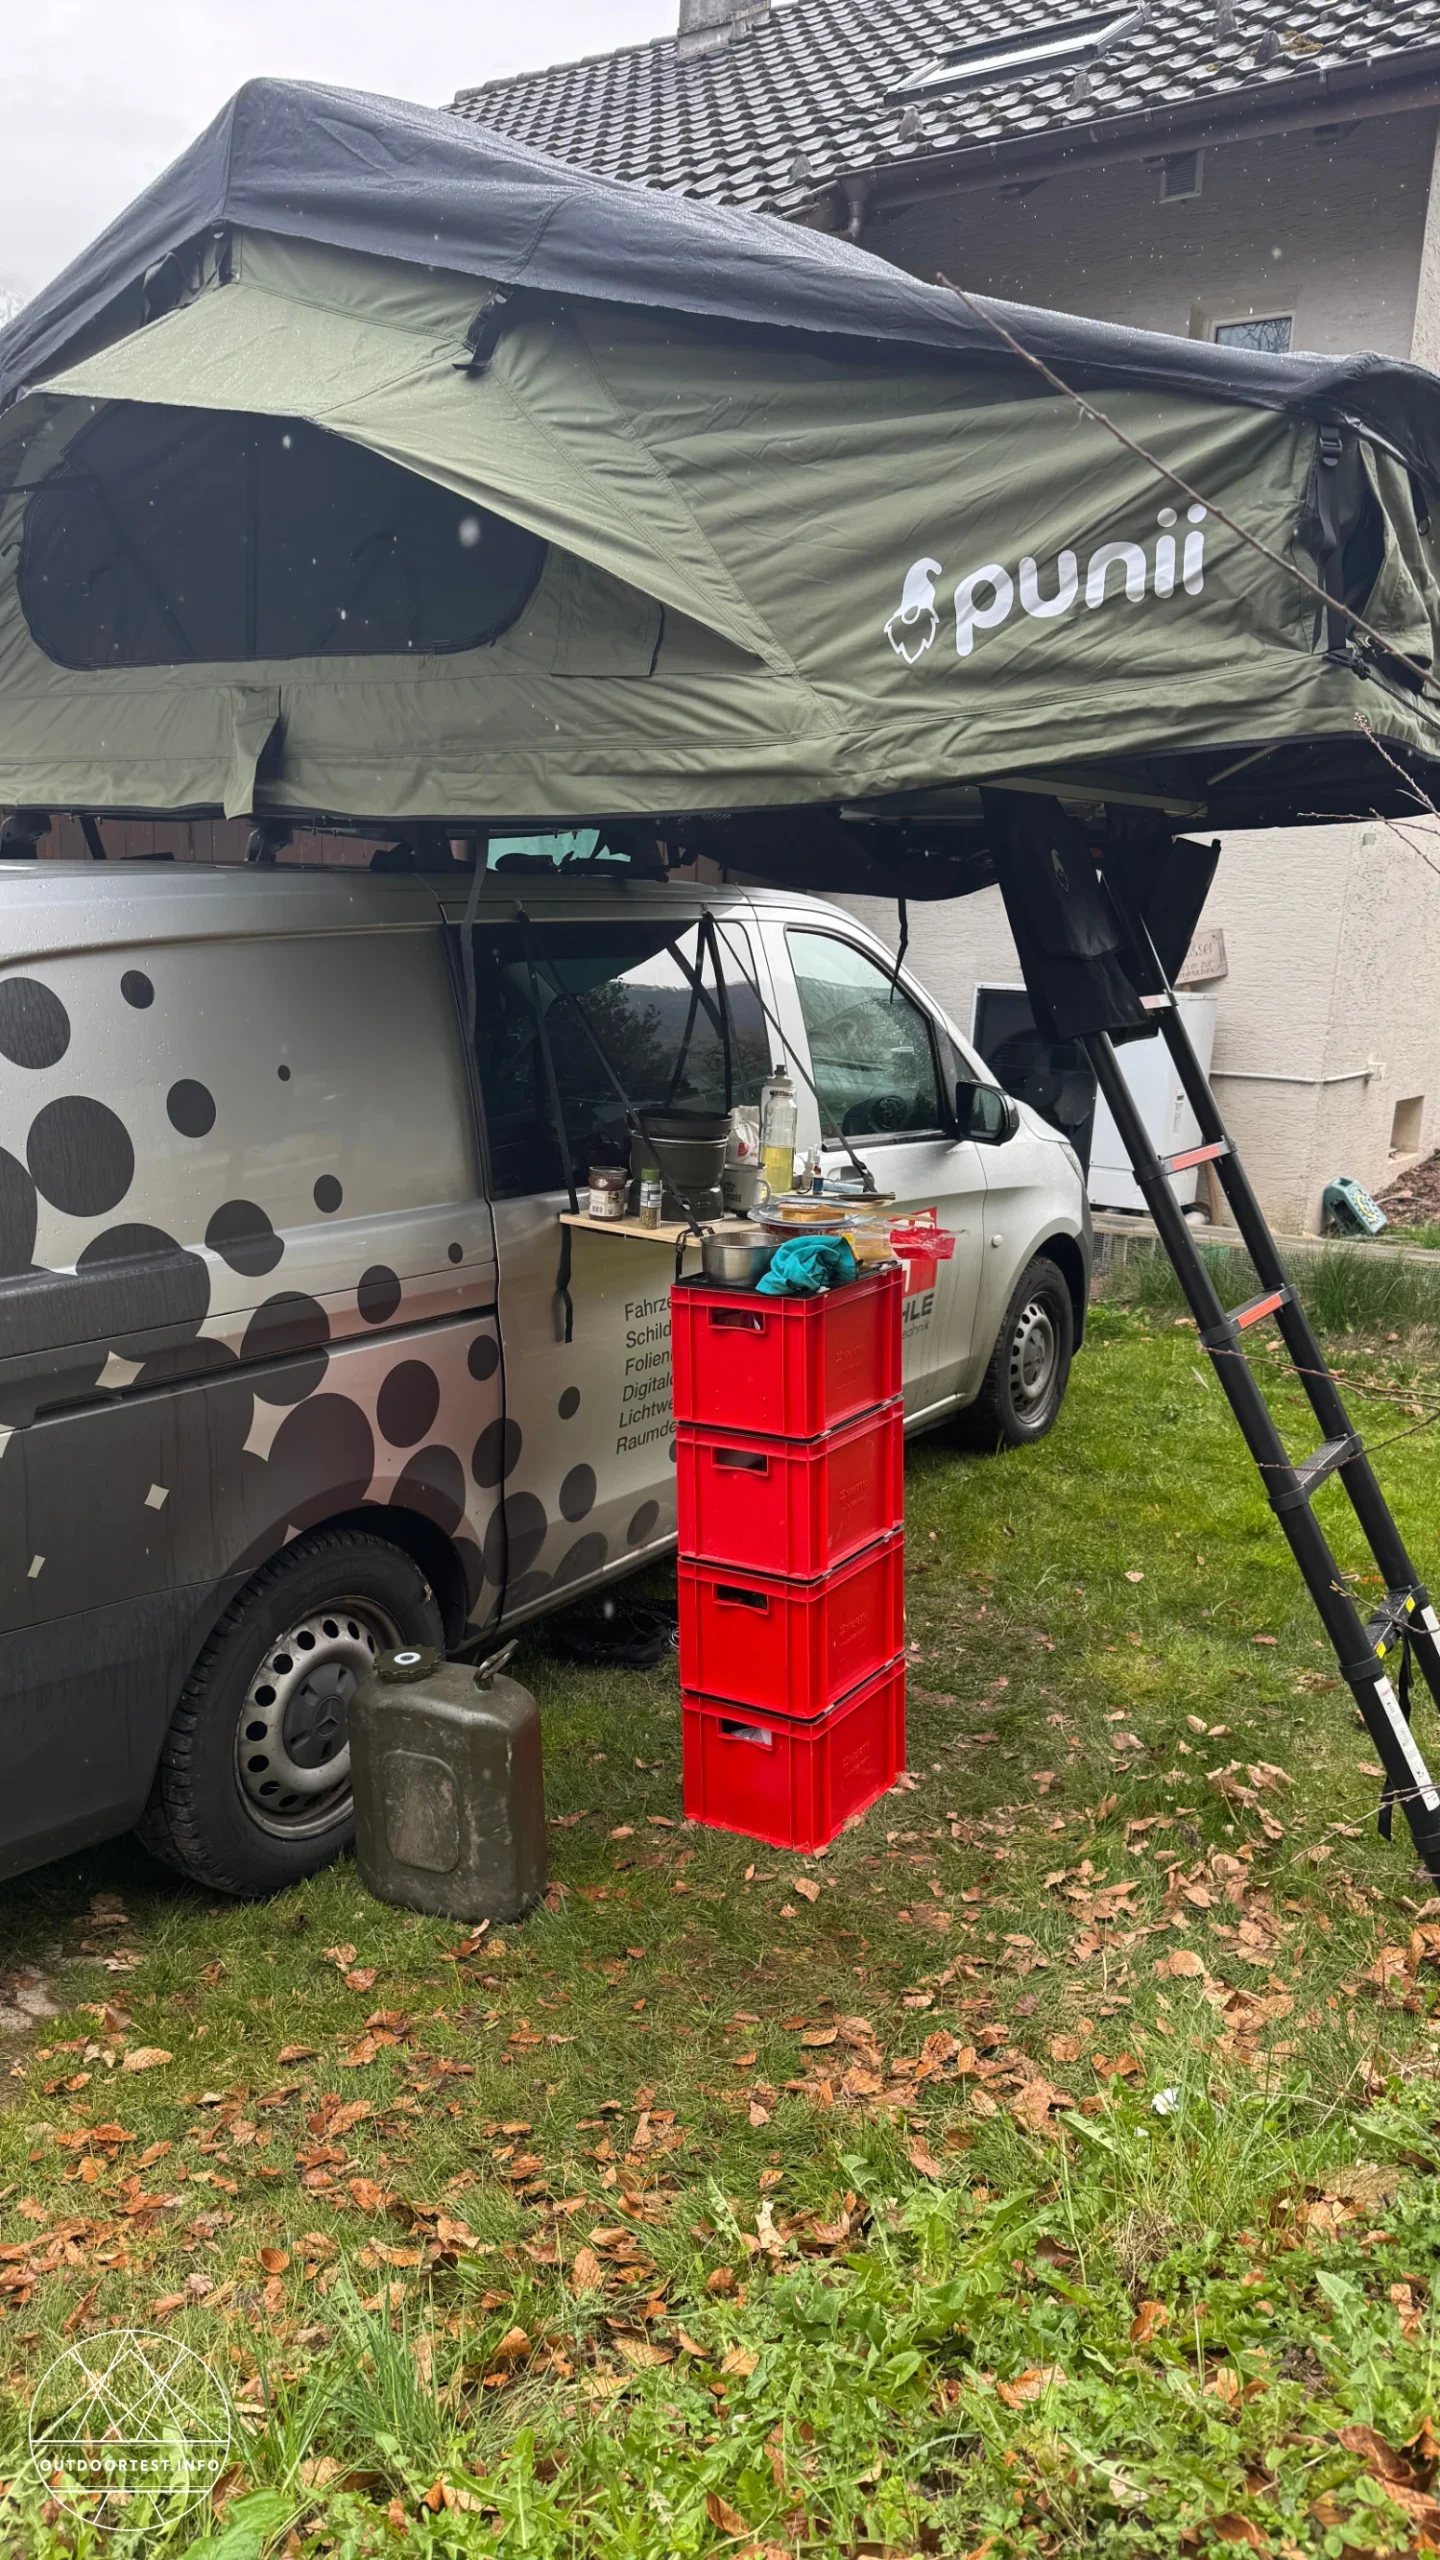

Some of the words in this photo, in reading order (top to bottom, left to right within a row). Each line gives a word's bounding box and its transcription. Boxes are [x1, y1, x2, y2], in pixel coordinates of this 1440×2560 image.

[953, 503, 1207, 657] punii
[625, 1320, 671, 1348] Schild
[625, 1350, 673, 1376] Folien
[616, 1420, 676, 1455] Raumde
